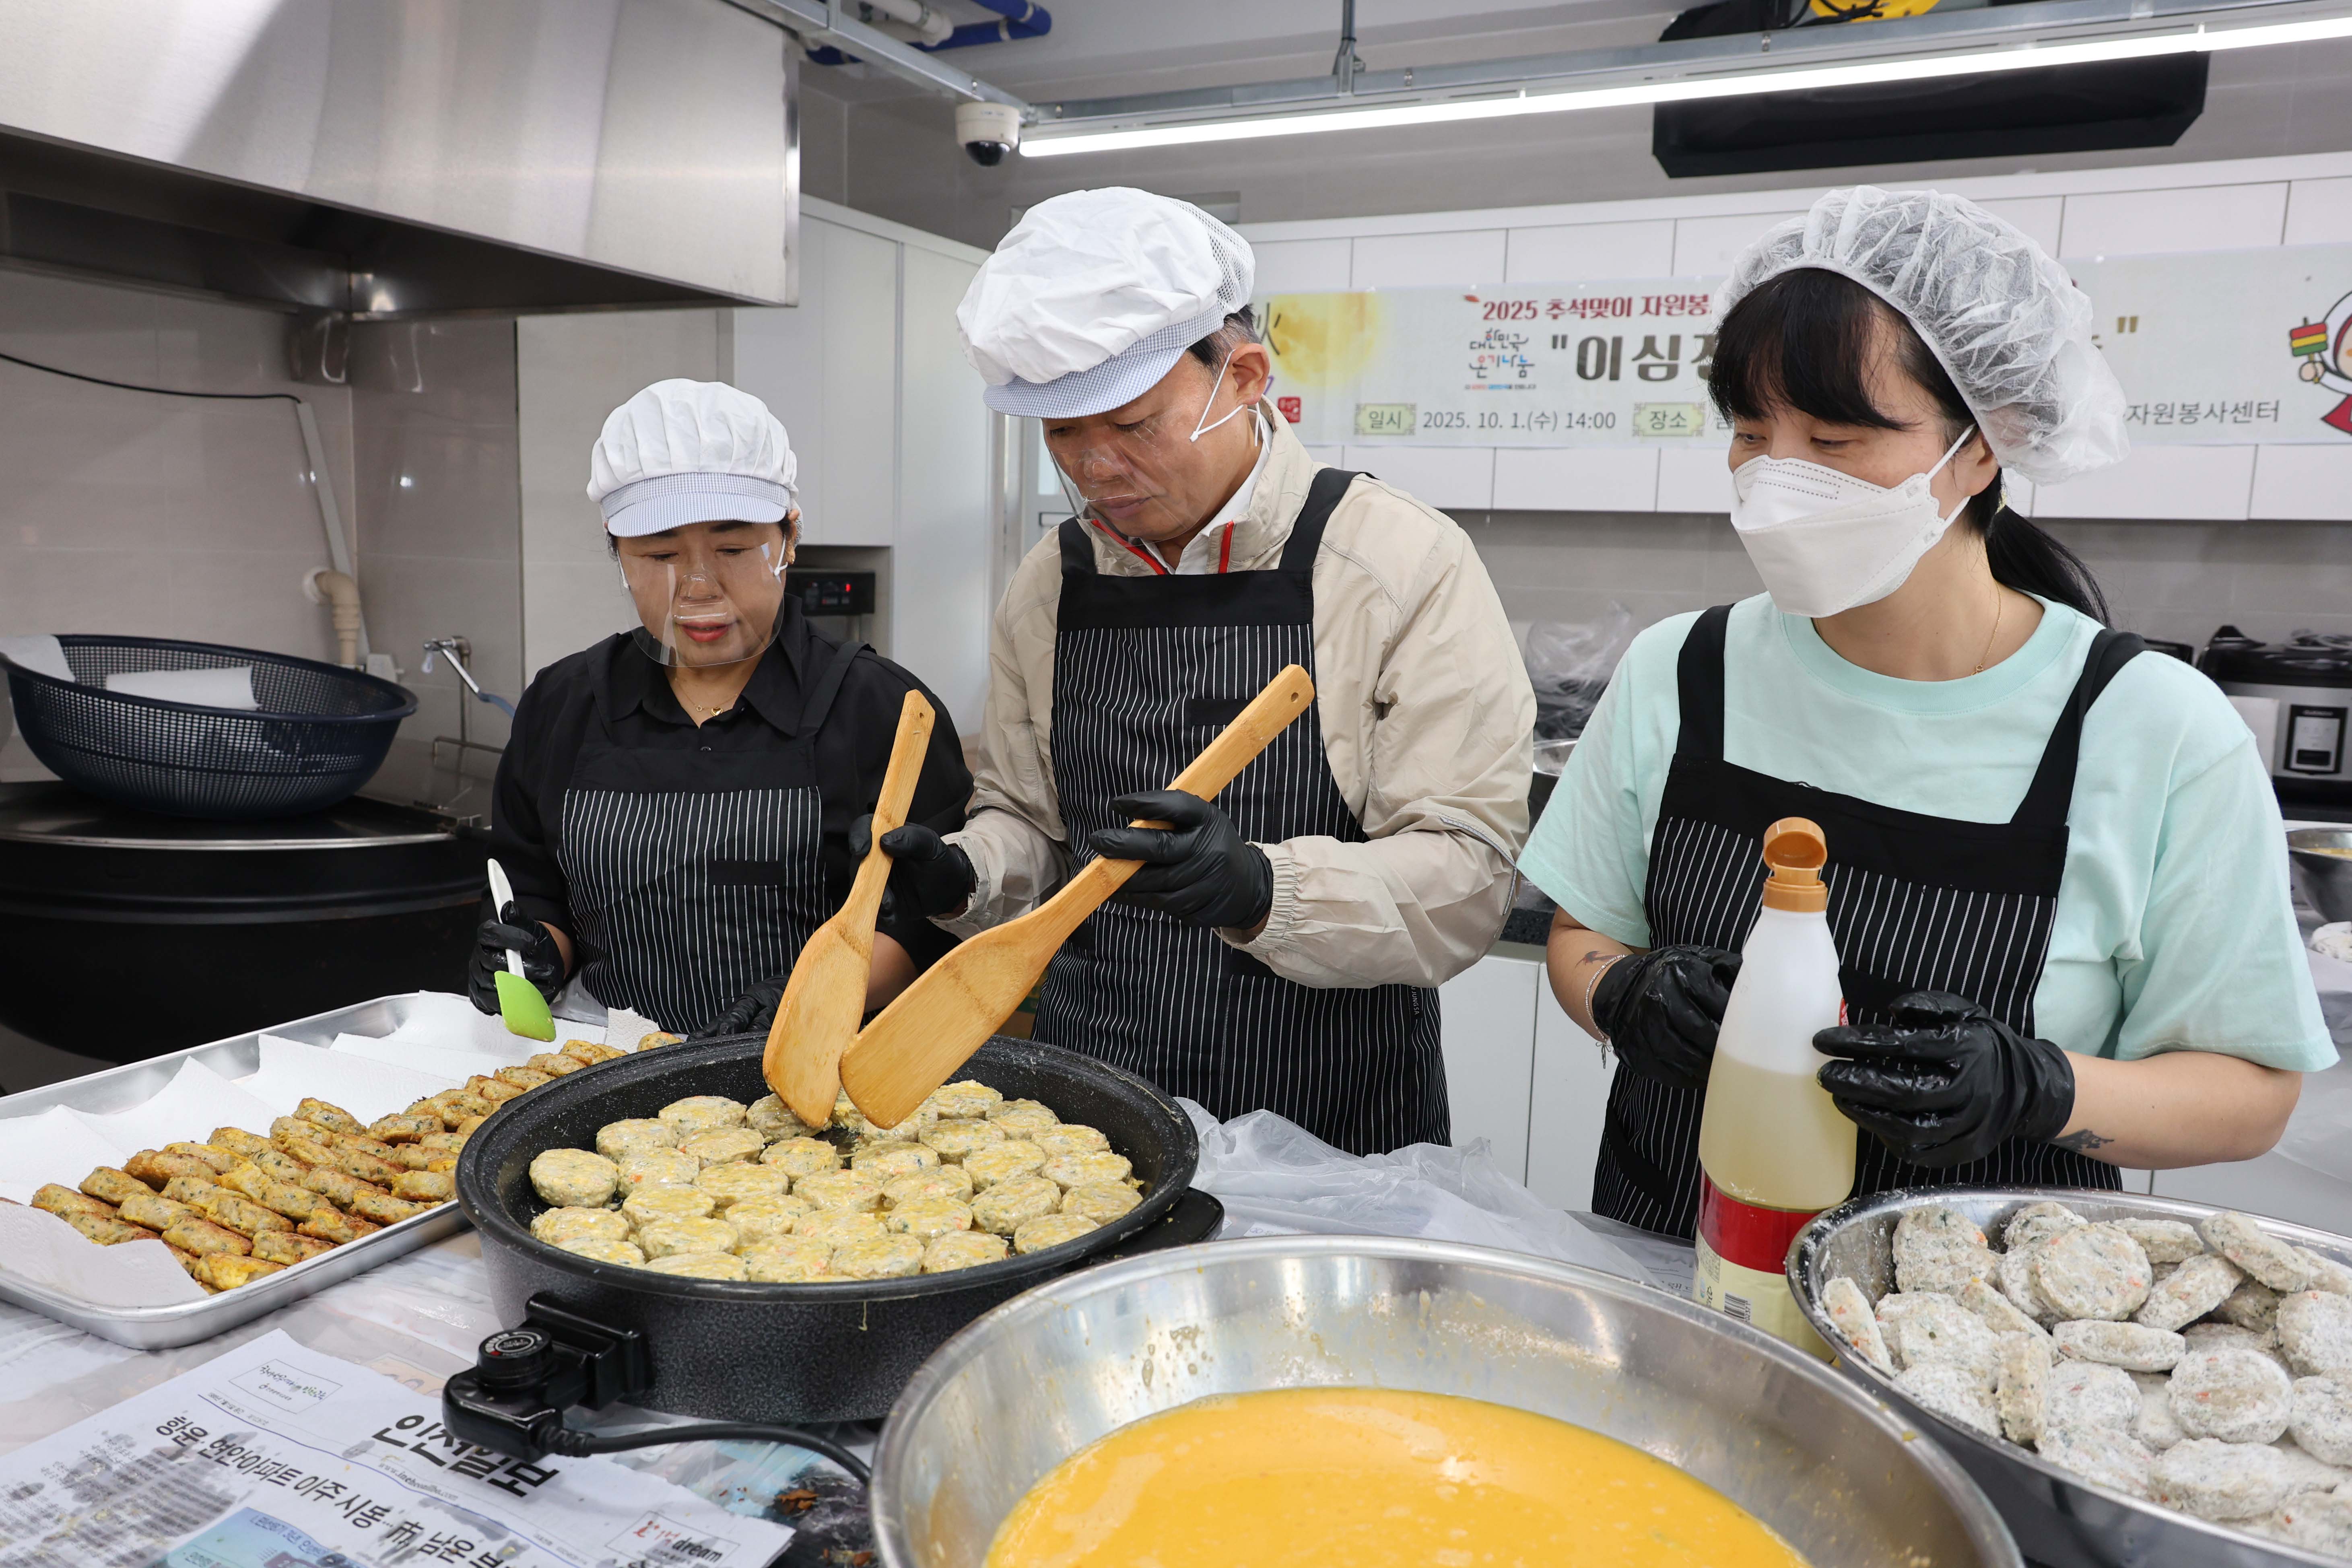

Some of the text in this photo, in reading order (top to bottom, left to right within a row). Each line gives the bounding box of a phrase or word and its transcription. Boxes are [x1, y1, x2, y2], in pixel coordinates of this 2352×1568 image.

[1483, 294, 1712, 320] 2025 추석맞이 자원봉
[1470, 327, 1529, 352] 대한민국
[1469, 354, 1535, 378] 온기나눔
[1369, 410, 1402, 429] 일시
[1423, 411, 1470, 429] 2025.
[1478, 412, 1503, 429] 10.
[1566, 412, 1616, 429] 14:00
[1649, 410, 1687, 430] 장소
[2123, 399, 2280, 425] 자원봉사센터
[294, 1476, 348, 1502] 이주
